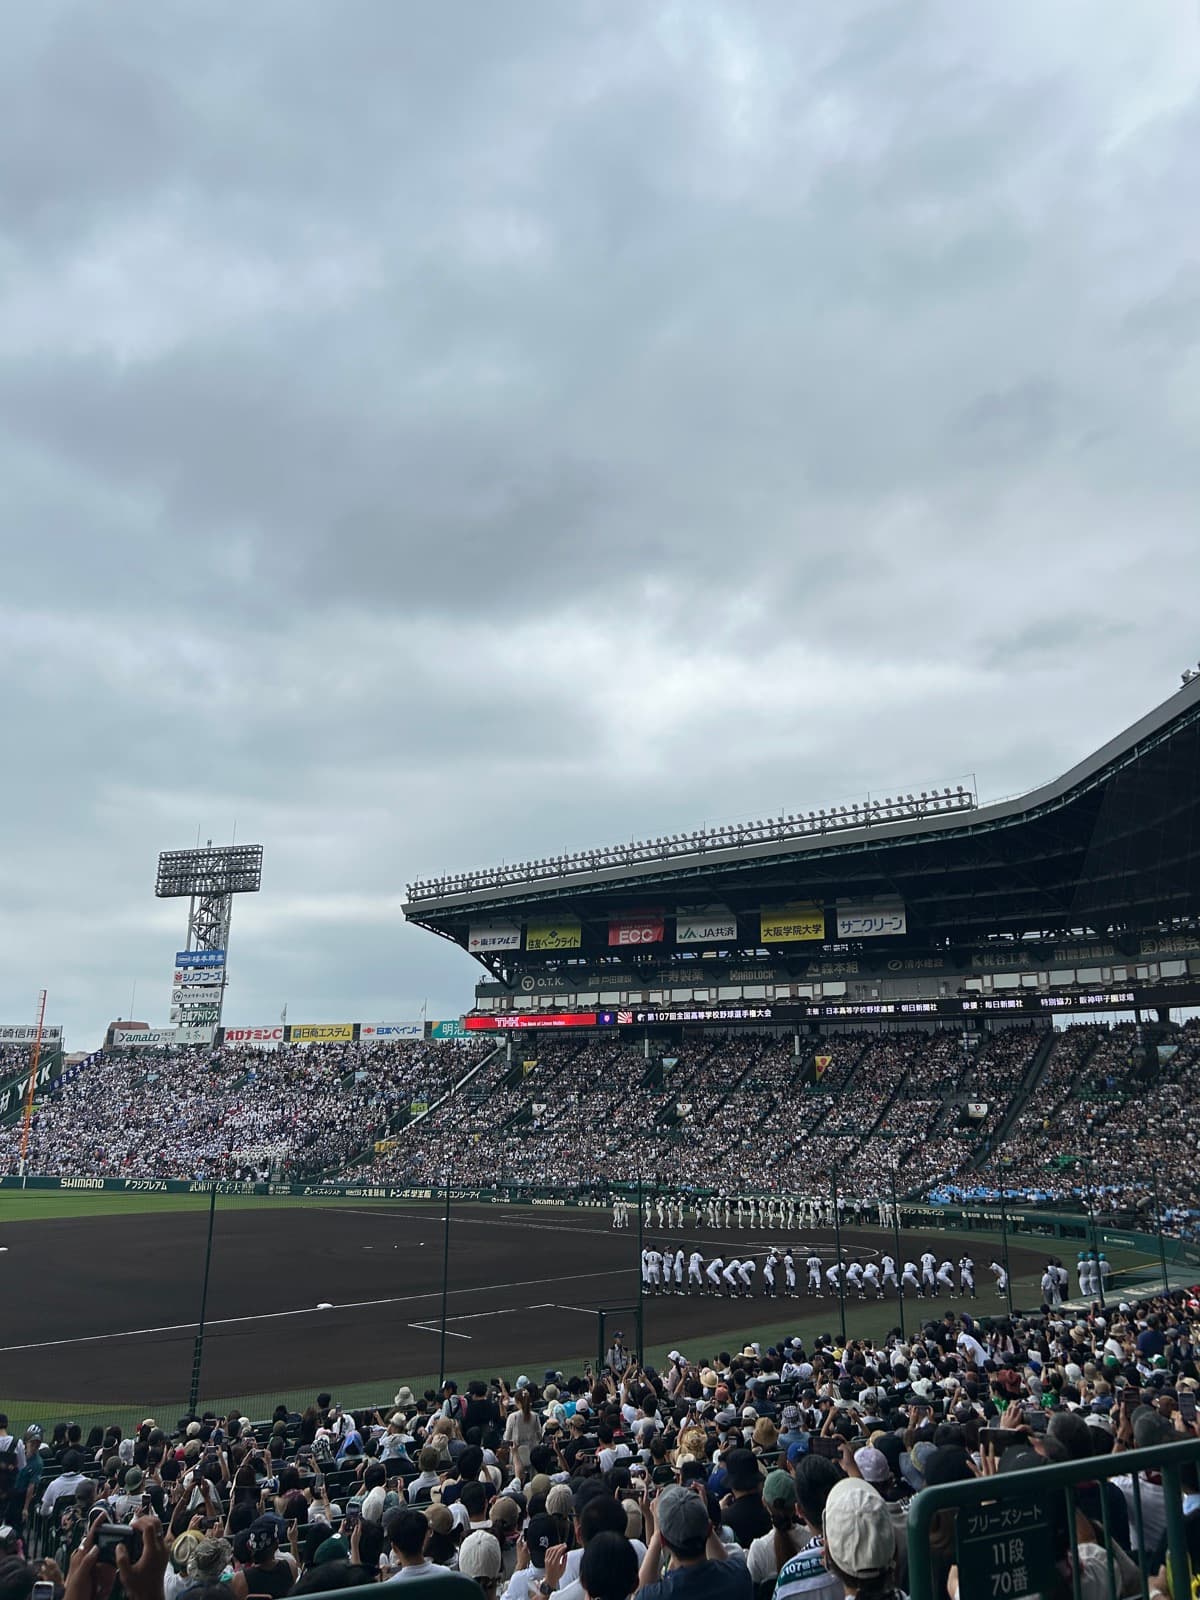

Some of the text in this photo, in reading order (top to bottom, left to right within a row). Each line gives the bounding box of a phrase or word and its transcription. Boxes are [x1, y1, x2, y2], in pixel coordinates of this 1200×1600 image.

[763, 924, 822, 937] 大阪学院大学
[841, 917, 903, 934] サニクリーン
[619, 928, 652, 944] ECC
[699, 926, 734, 938] JA共済
[480, 936, 519, 946] 東洋アルミ
[528, 936, 579, 950] 住友ベークライト
[821, 961, 859, 975] 森本組
[183, 971, 222, 982] シノブフーズ
[119, 1032, 161, 1042] Yamato
[226, 1028, 283, 1040] オロナミンC
[302, 1028, 350, 1038] 日商エステム
[18, 1062, 52, 1100] YKK
[60, 1178, 104, 1188] SHIMANO
[532, 1198, 565, 1206] Okamura
[992, 1538, 1024, 1566] 11段
[992, 1566, 1028, 1596] 70番
